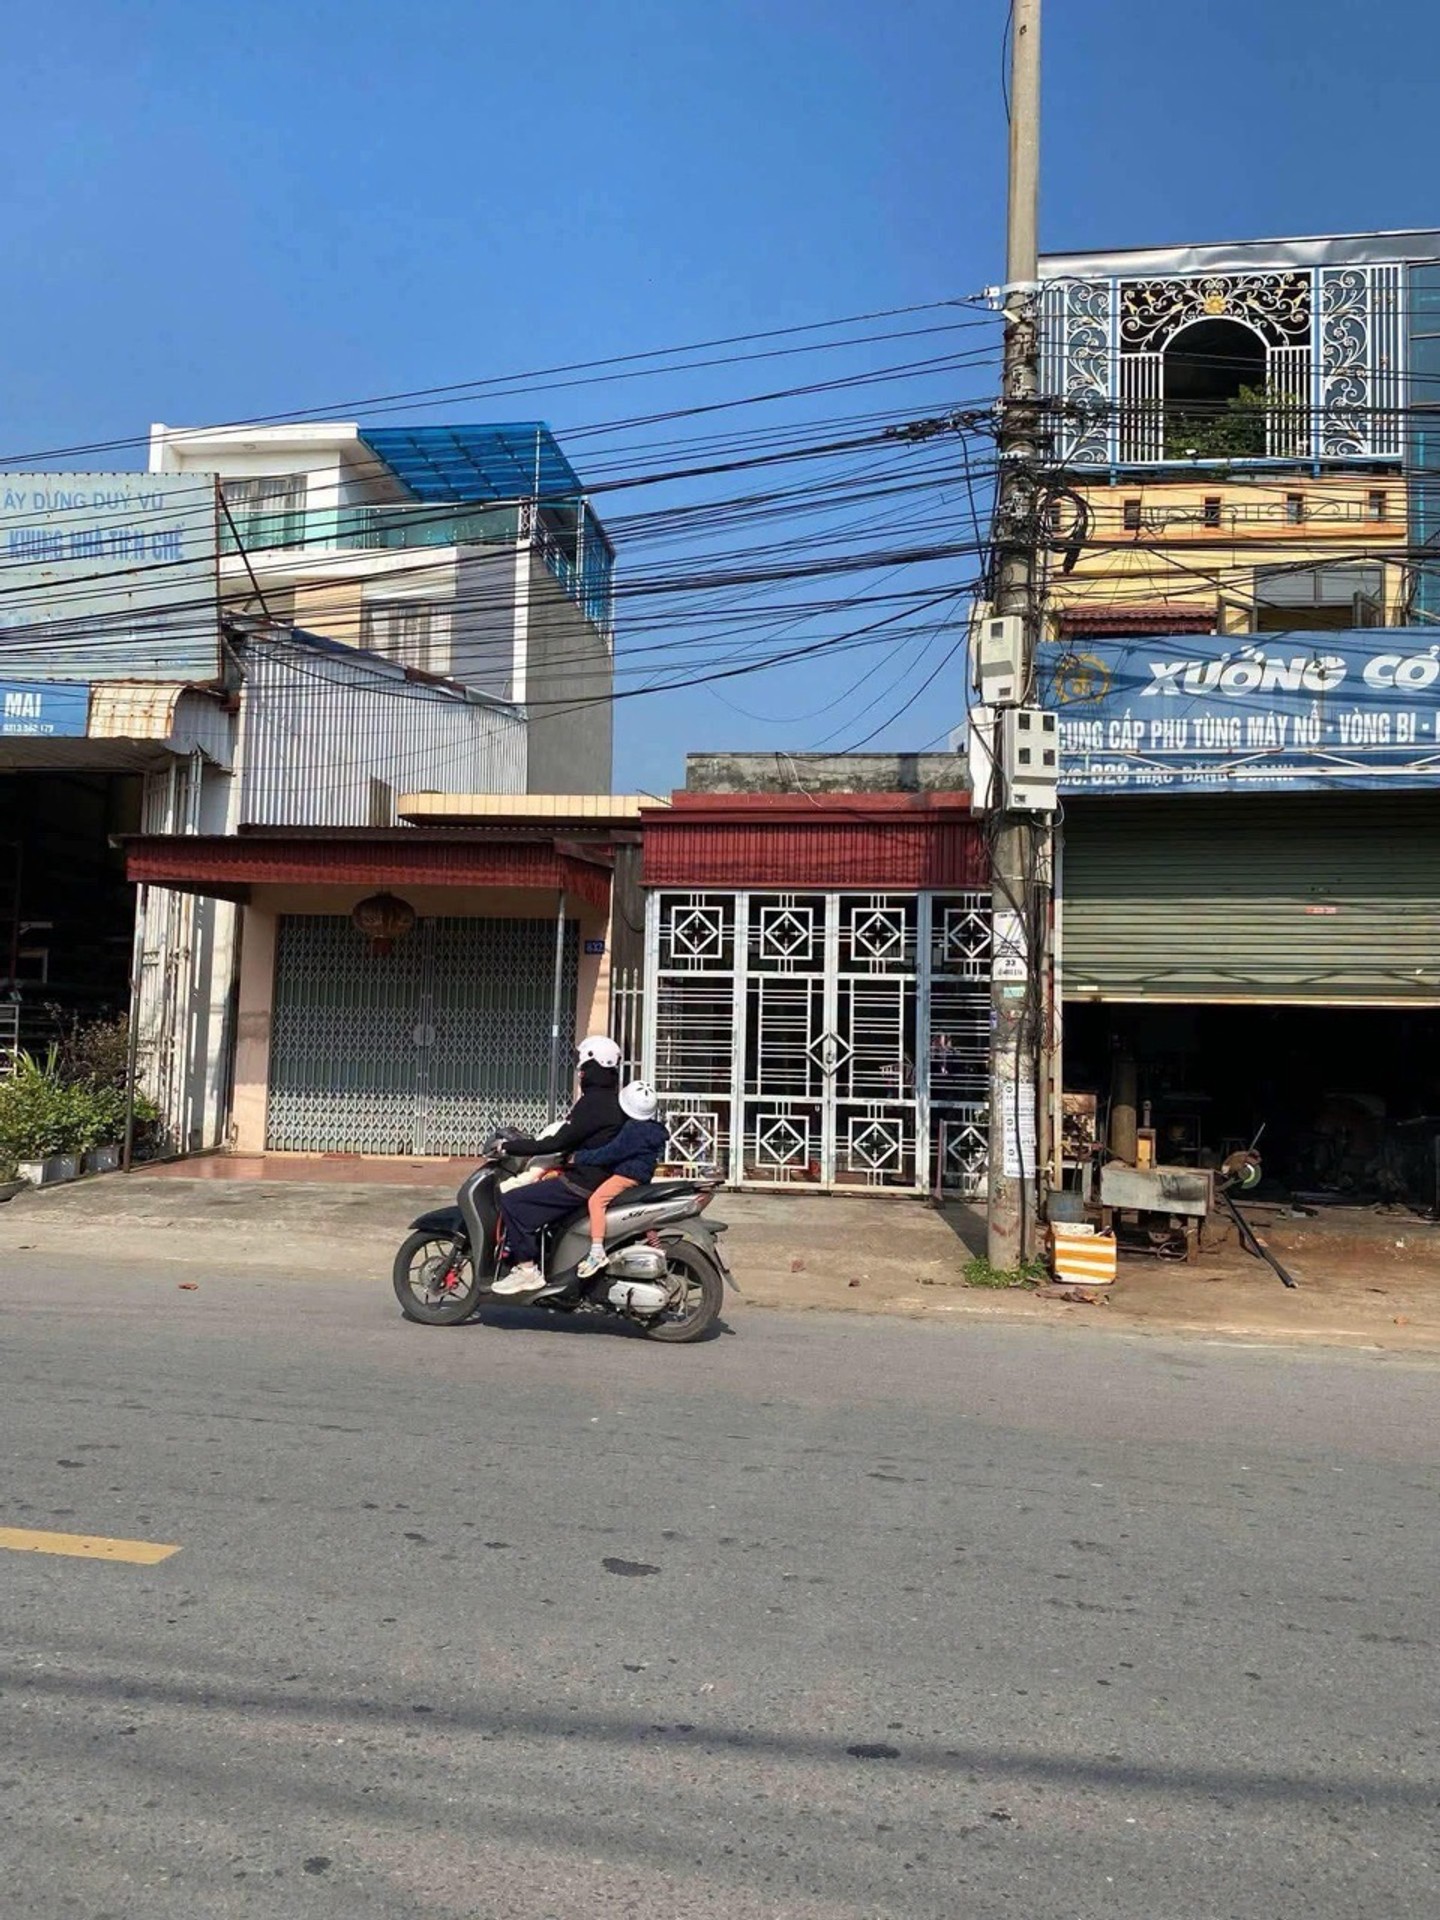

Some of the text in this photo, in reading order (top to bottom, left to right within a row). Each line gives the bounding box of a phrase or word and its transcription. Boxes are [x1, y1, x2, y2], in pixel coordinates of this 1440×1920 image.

[93, 491, 132, 511] DUY
[1139, 645, 1349, 697] XƯỞNG
[4, 693, 42, 719] MAI
[1057, 720, 1103, 751] CUNG
[1109, 708, 1145, 749] CẤP
[1151, 718, 1187, 751] PHỤ
[1193, 711, 1241, 749] TÙNG
[1246, 710, 1288, 747] MÁY
[1293, 699, 1320, 745] NỔ
[1339, 706, 1390, 745] VÒNG
[1396, 712, 1416, 743] BI
